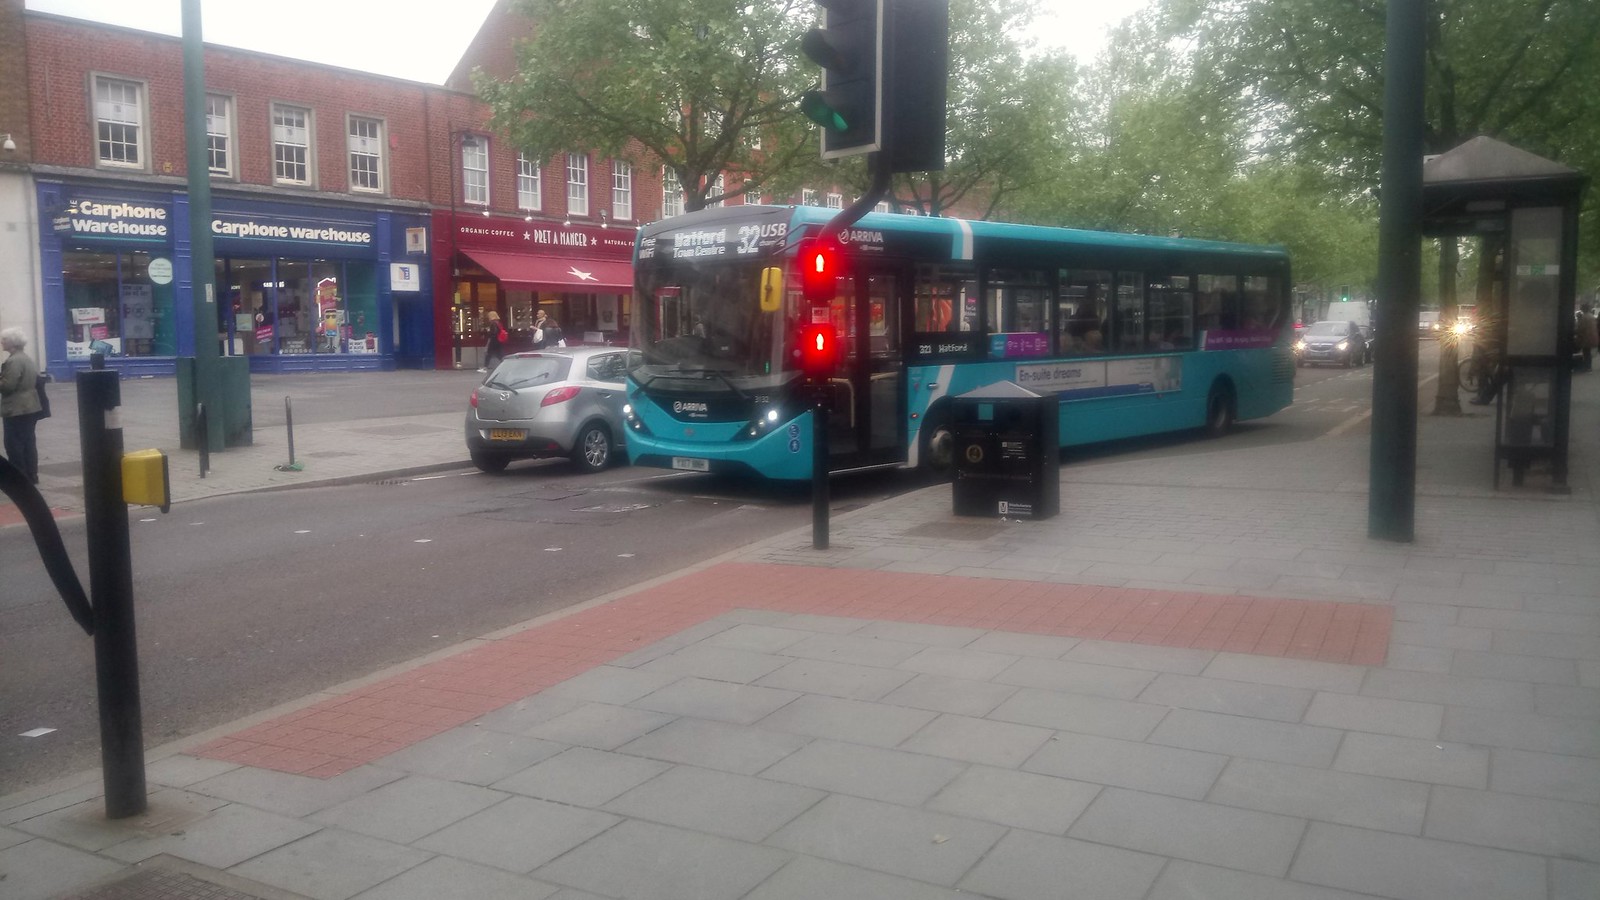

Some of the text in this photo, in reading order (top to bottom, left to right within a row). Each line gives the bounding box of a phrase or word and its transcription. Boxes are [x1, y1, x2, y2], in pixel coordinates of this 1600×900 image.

[80, 201, 166, 219] Carphone
[71, 219, 167, 235] Warehouse
[211, 220, 288, 237] Carphone
[460, 227, 489, 235] ORGANIC
[760, 223, 787, 238] USB
[534, 229, 587, 247] PRET A MANGER
[641, 237, 656, 247] Free
[850, 231, 884, 243] ARRIVA
[1019, 367, 1082, 382] En-suite dreams
[682, 402, 708, 412] ARRIVA
